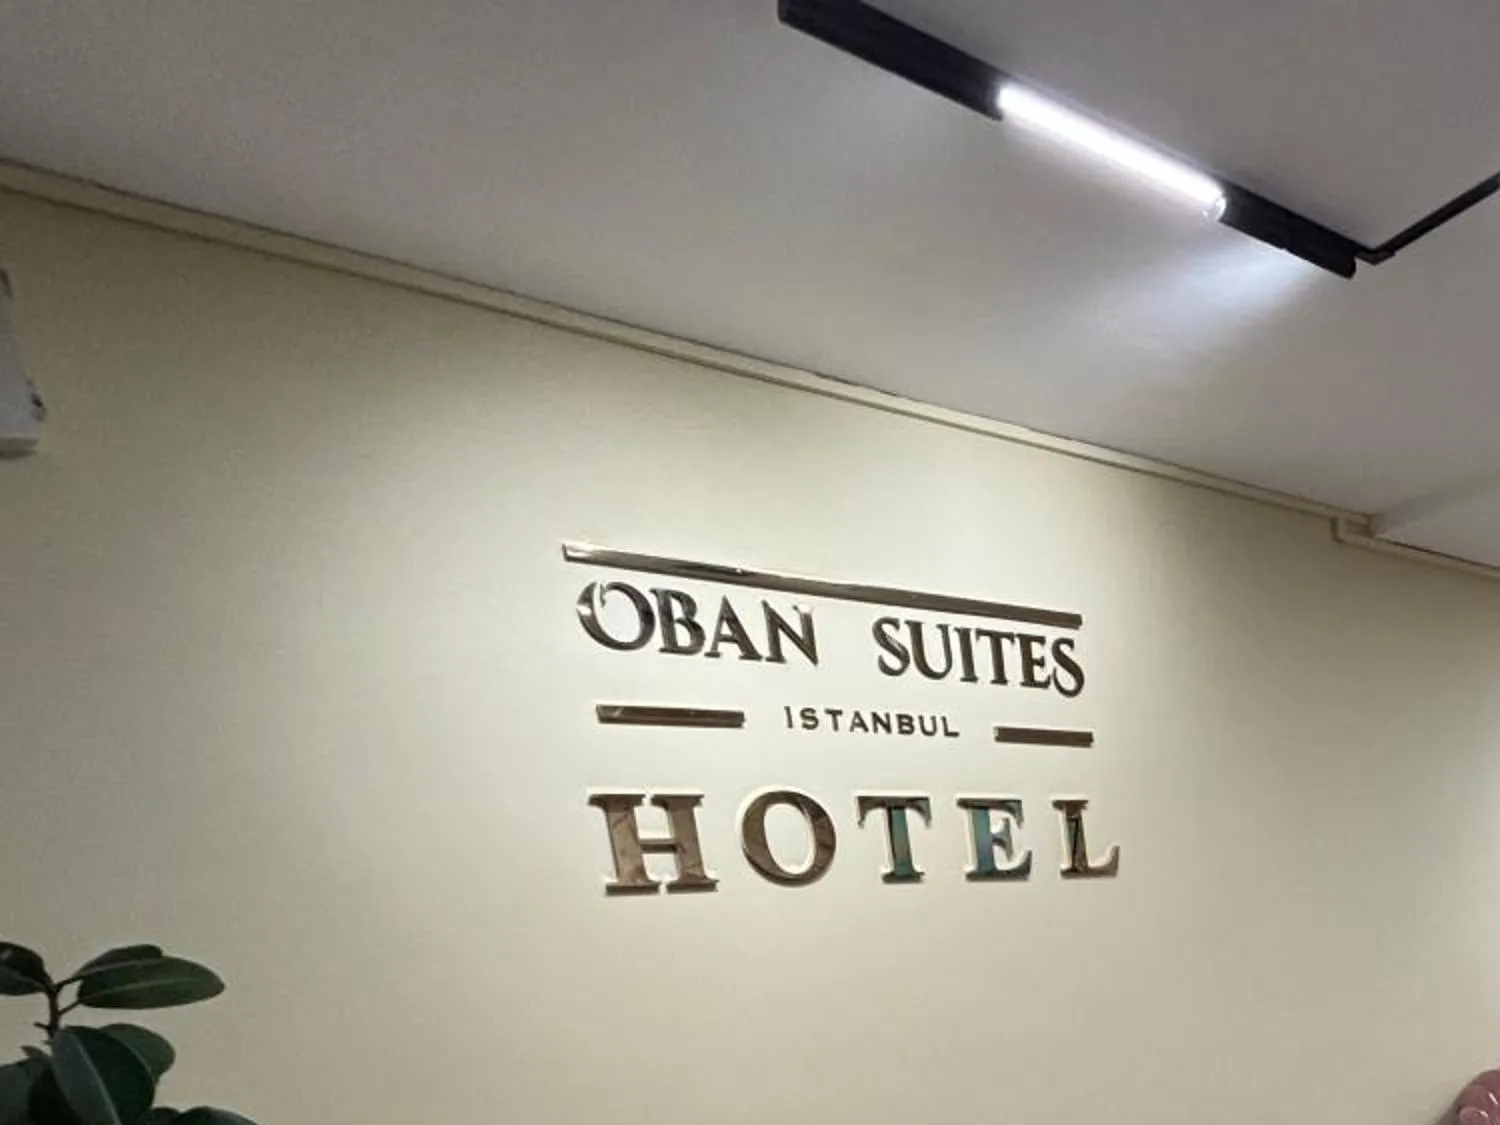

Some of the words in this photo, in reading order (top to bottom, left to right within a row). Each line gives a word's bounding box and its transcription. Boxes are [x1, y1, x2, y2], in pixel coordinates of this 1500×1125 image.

[577, 581, 819, 666] OBAN
[874, 616, 1085, 697] SUITES
[784, 705, 960, 738] ISTANBUL
[588, 789, 1119, 895] HOTEL
